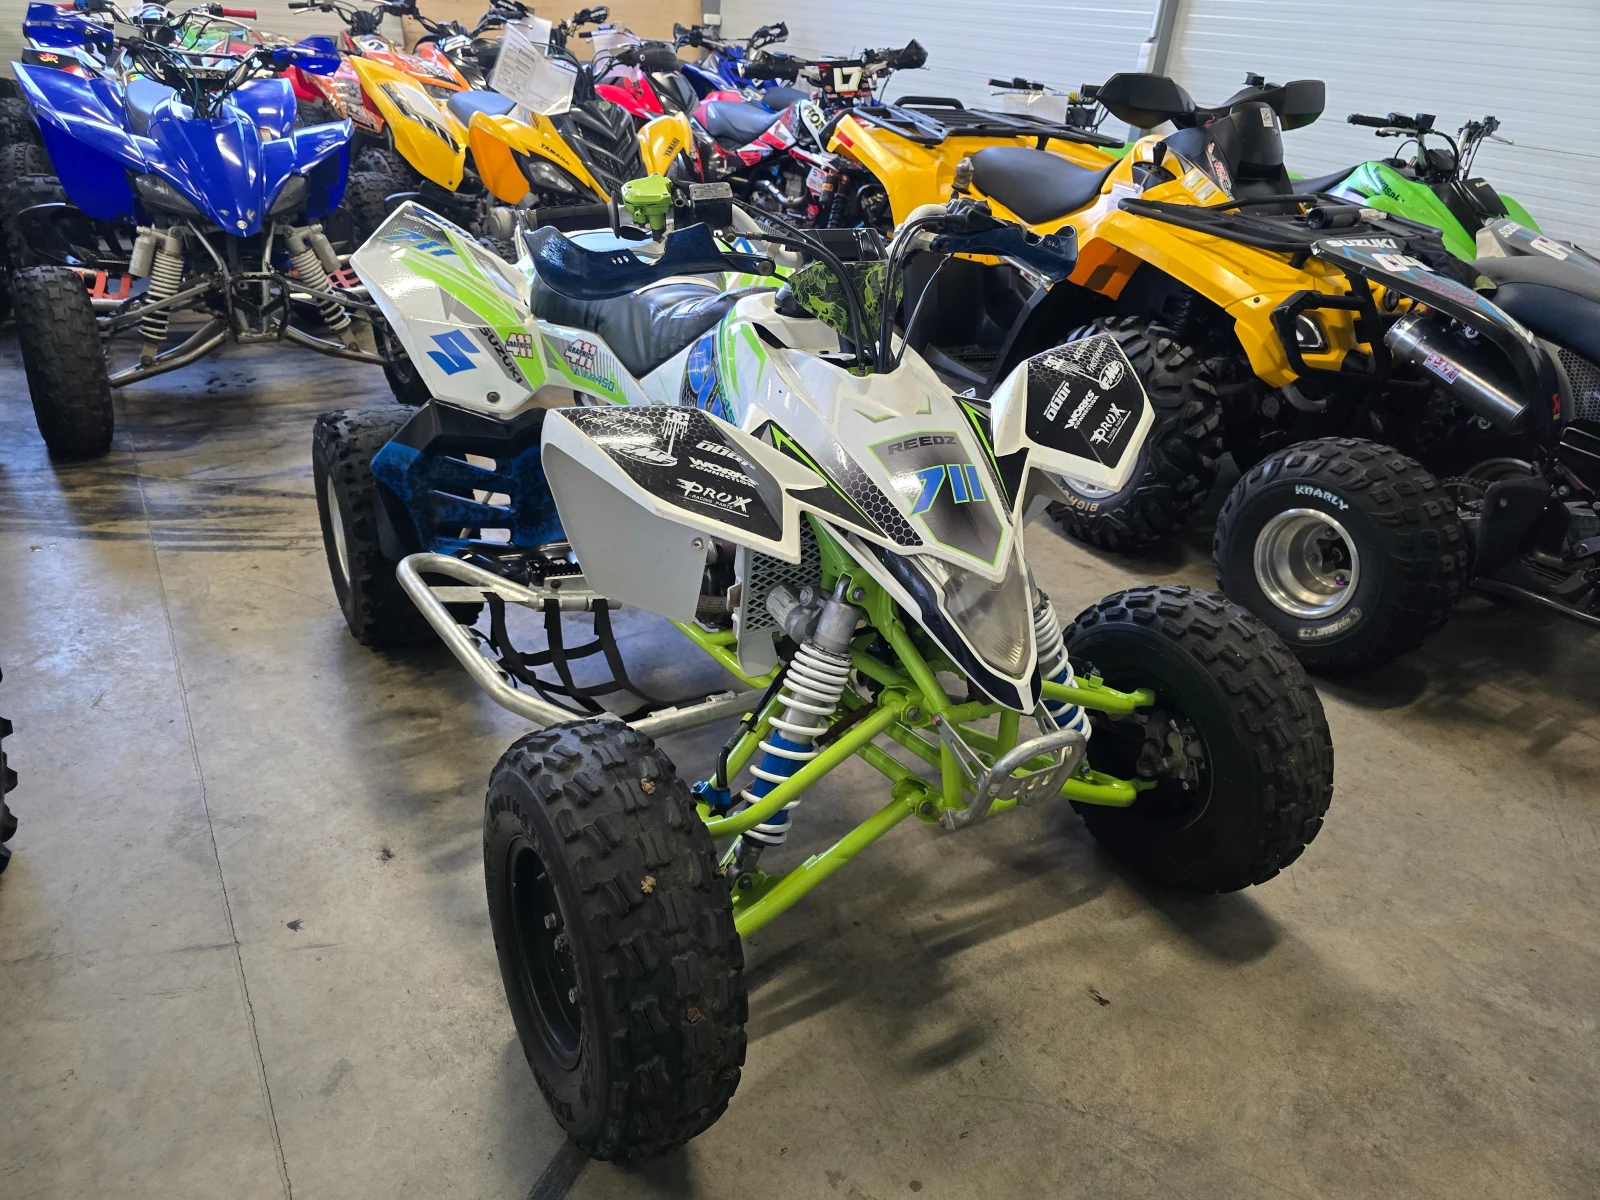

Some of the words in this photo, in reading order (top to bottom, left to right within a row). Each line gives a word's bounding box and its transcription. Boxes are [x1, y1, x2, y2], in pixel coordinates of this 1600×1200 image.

[540, 142, 571, 167] YAMAHA
[1326, 238, 1398, 249] SUZUKI
[479, 327, 524, 384] SUZUKI
[505, 332, 534, 360] 411
[506, 339, 532, 350] GRAPHICS
[564, 338, 598, 371] 411
[567, 344, 595, 361] GRAPHICS
[1100, 360, 1121, 391] FMF
[1063, 389, 1095, 429] WORKS
[1074, 395, 1100, 430] CONNECTION
[887, 435, 958, 456] REEDZ
[688, 456, 760, 486] WORKS
[689, 463, 756, 489] CONNECTION
[691, 494, 713, 504] RACING
[714, 501, 734, 510] PARTS
[905, 464, 987, 517] 711
